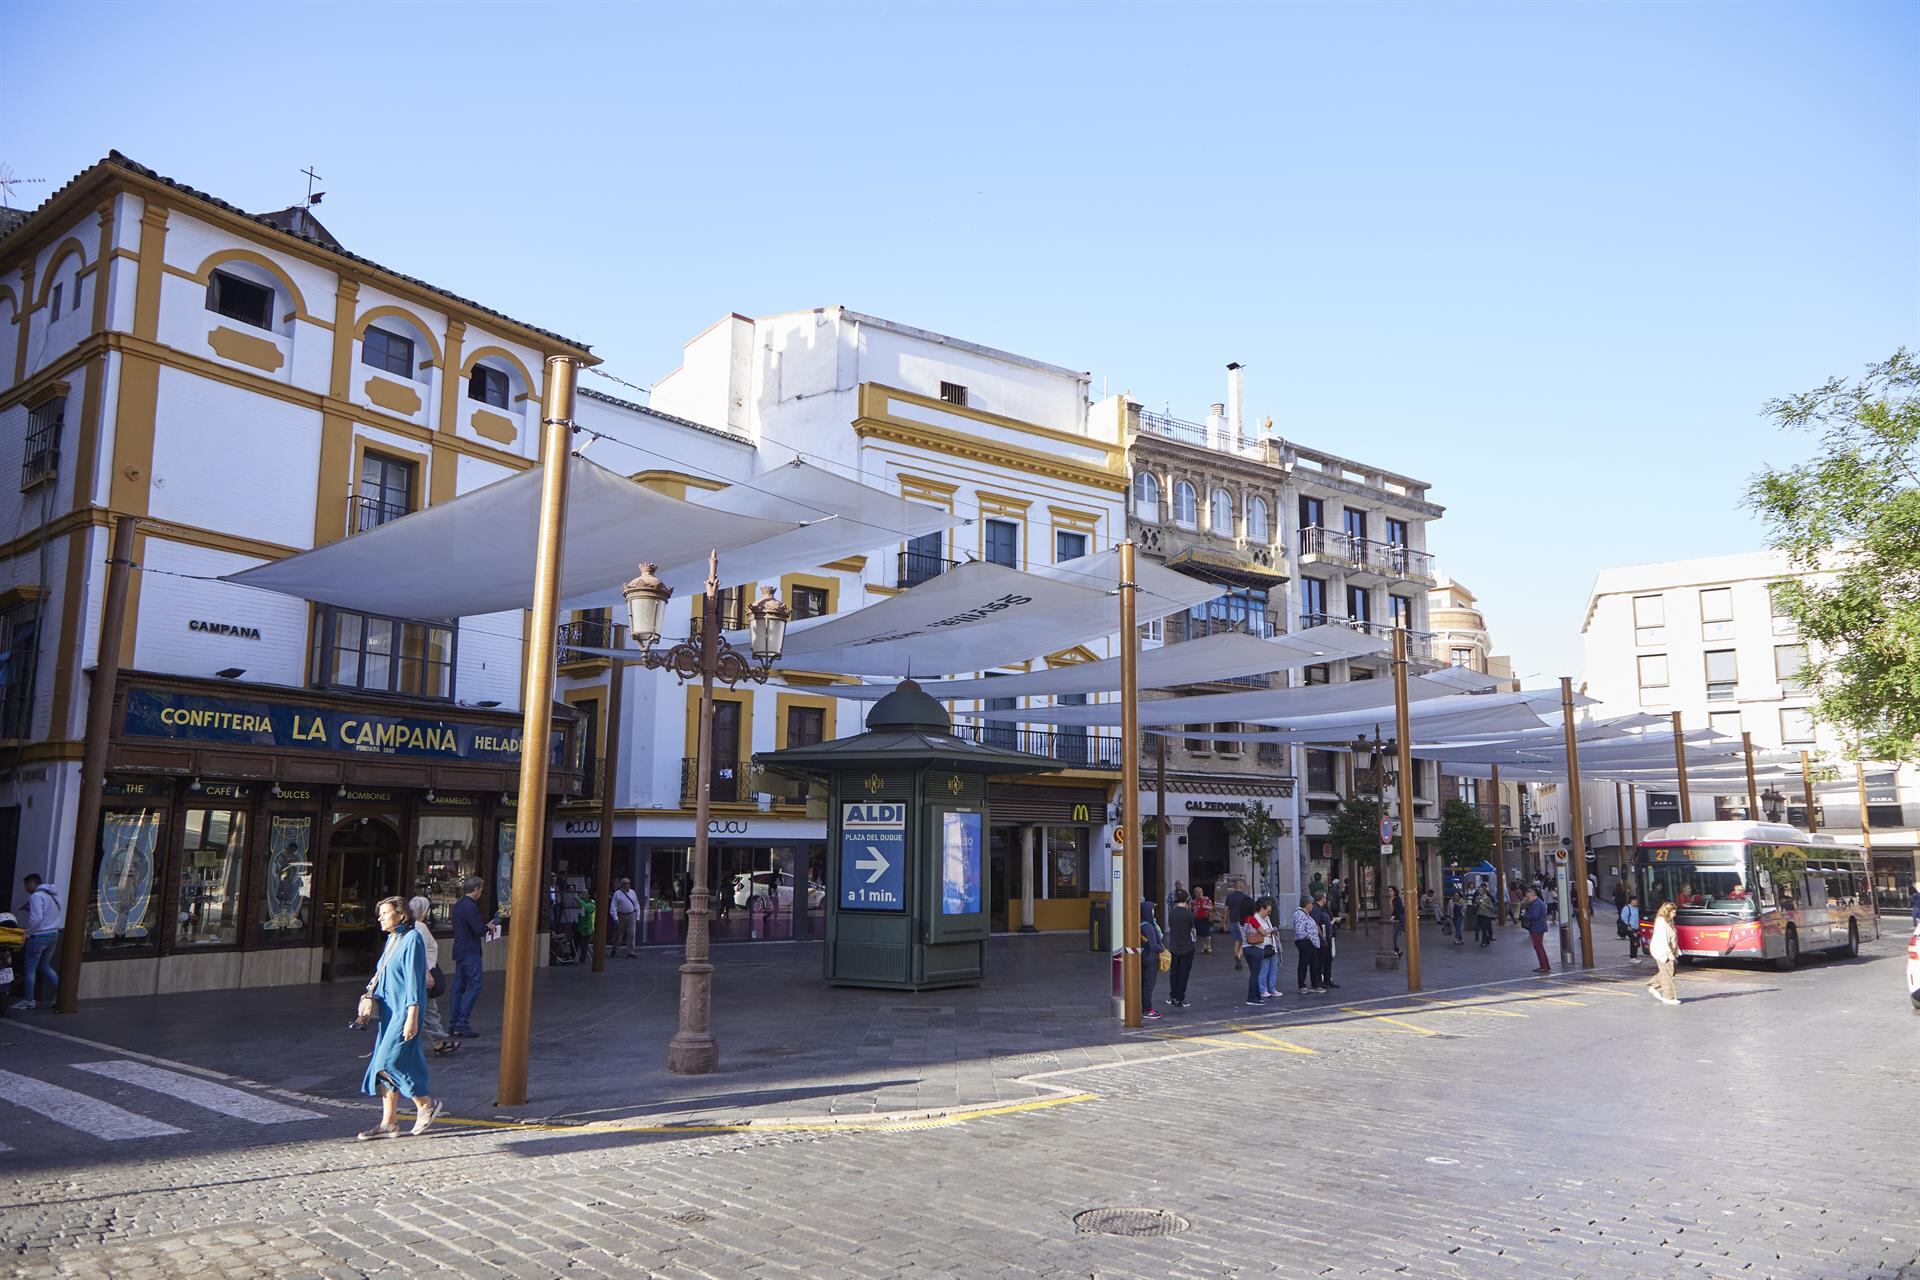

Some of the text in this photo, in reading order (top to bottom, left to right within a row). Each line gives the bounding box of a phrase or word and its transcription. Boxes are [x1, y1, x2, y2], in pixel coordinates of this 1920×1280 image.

[189, 620, 261, 640] CAMPANA
[160, 707, 272, 733] CONFITERIA
[292, 715, 327, 742] LA
[340, 720, 457, 752] CAMPANA
[126, 784, 144, 793] THE
[277, 790, 310, 800] DULCES
[347, 791, 391, 800] BOMBONES
[846, 805, 903, 822] ALDI
[845, 833, 865, 841] PLAZA
[1656, 849, 1669, 861] 27
[848, 889, 896, 902] a 1 min.
